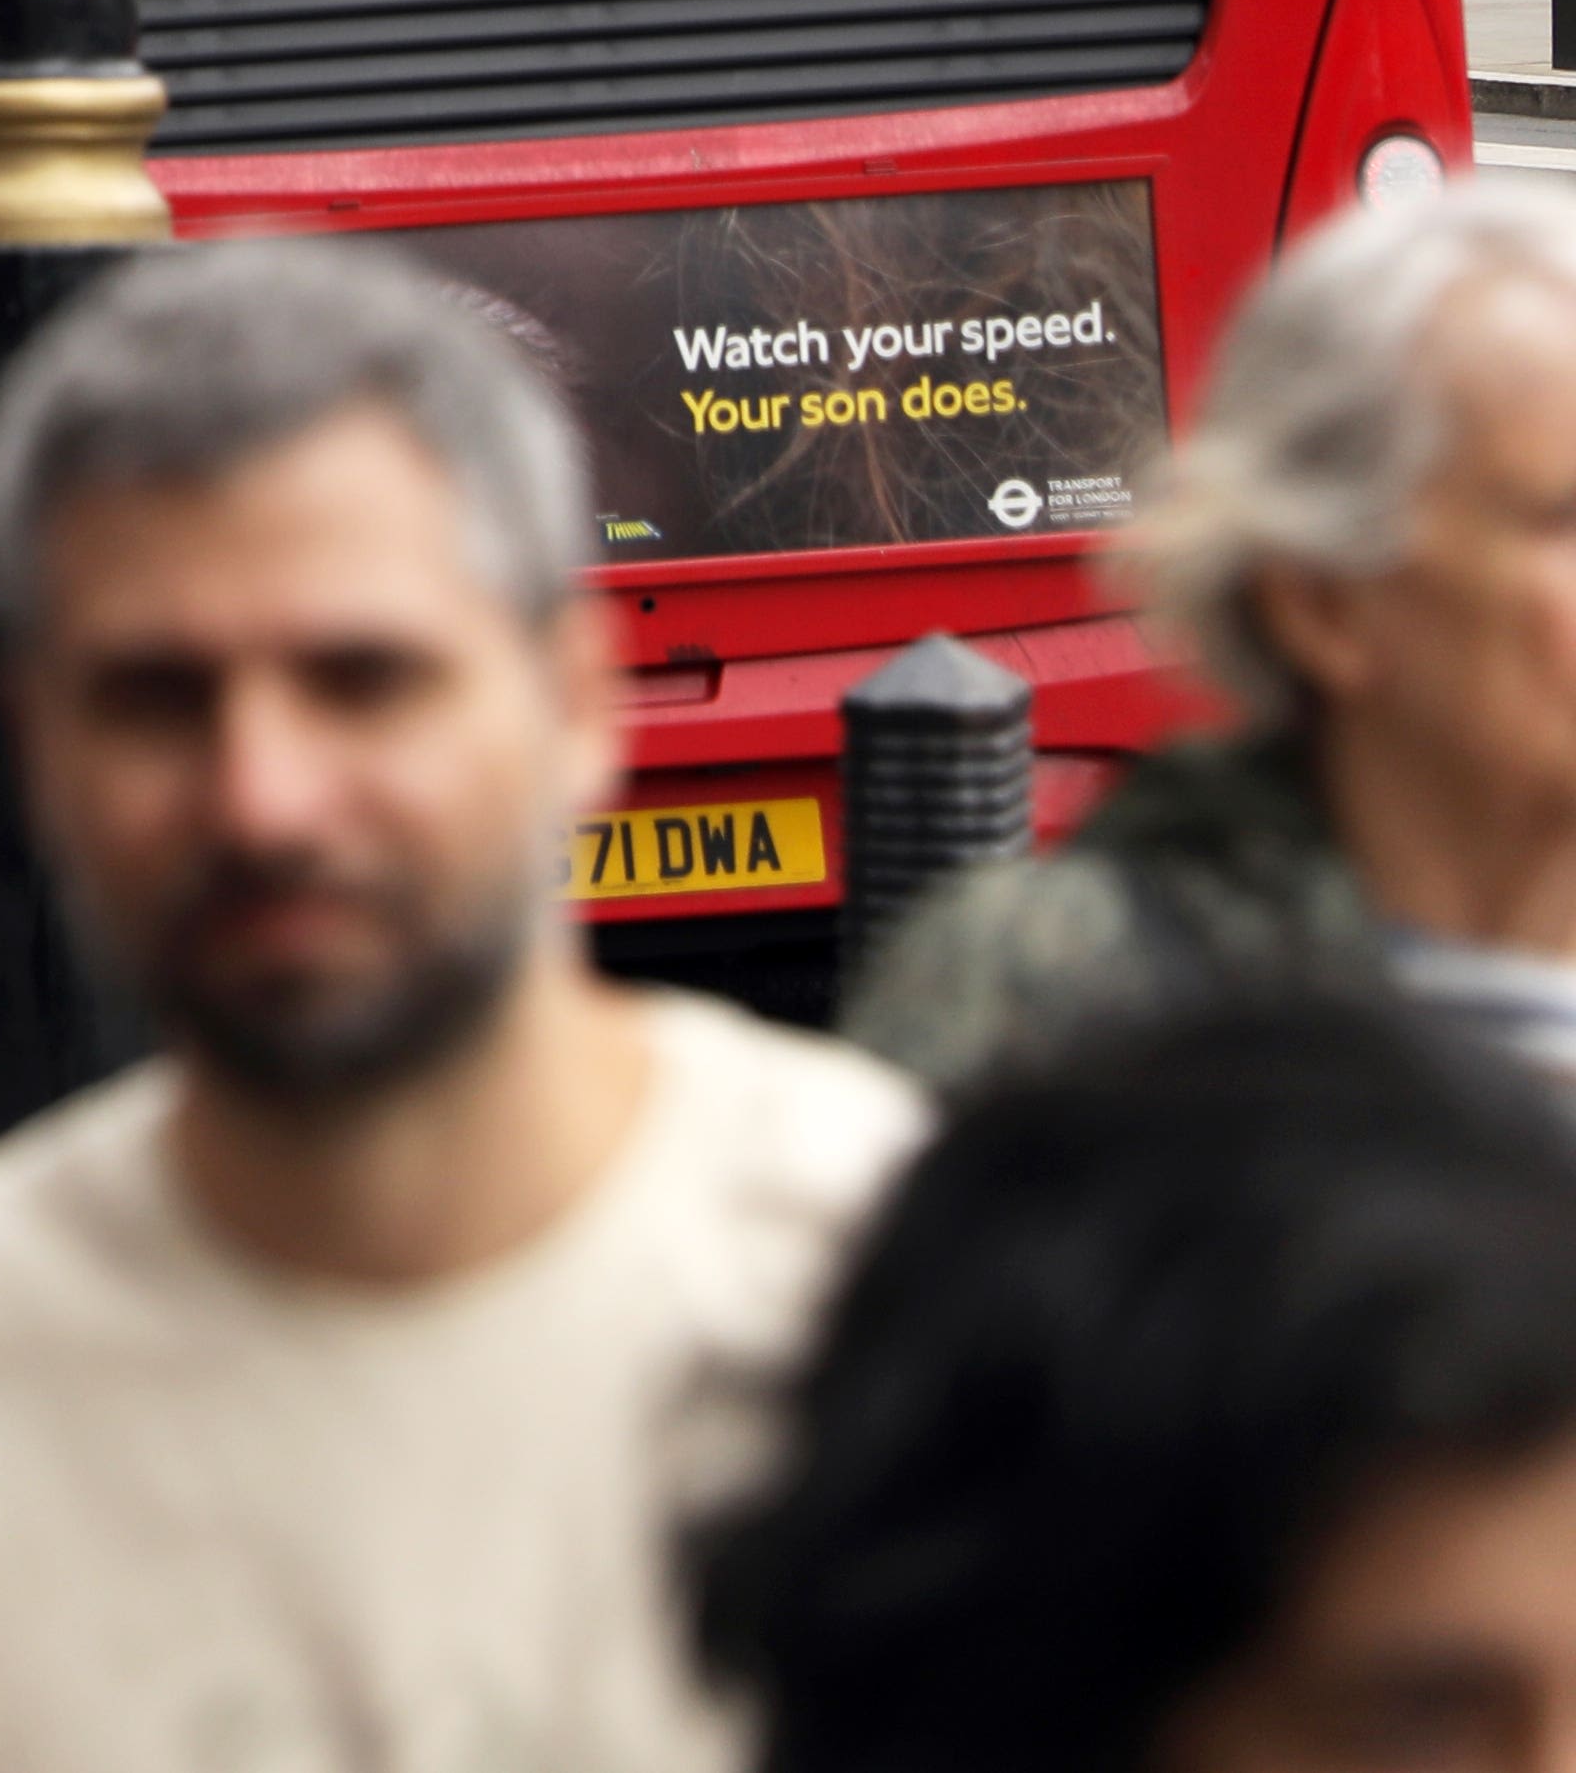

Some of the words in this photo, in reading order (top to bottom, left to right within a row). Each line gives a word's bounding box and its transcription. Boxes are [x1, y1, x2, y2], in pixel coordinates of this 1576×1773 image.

[674, 321, 829, 372] Watch
[844, 322, 953, 370] your
[961, 302, 1117, 369] speed.
[681, 389, 791, 434] Your
[800, 390, 886, 426] son
[901, 376, 1028, 421] does.
[1047, 476, 1122, 492] TRANSPORT
[1047, 493, 1073, 506] FOR
[1075, 490, 1132, 505] LONDON
[654, 811, 782, 880] DWA
